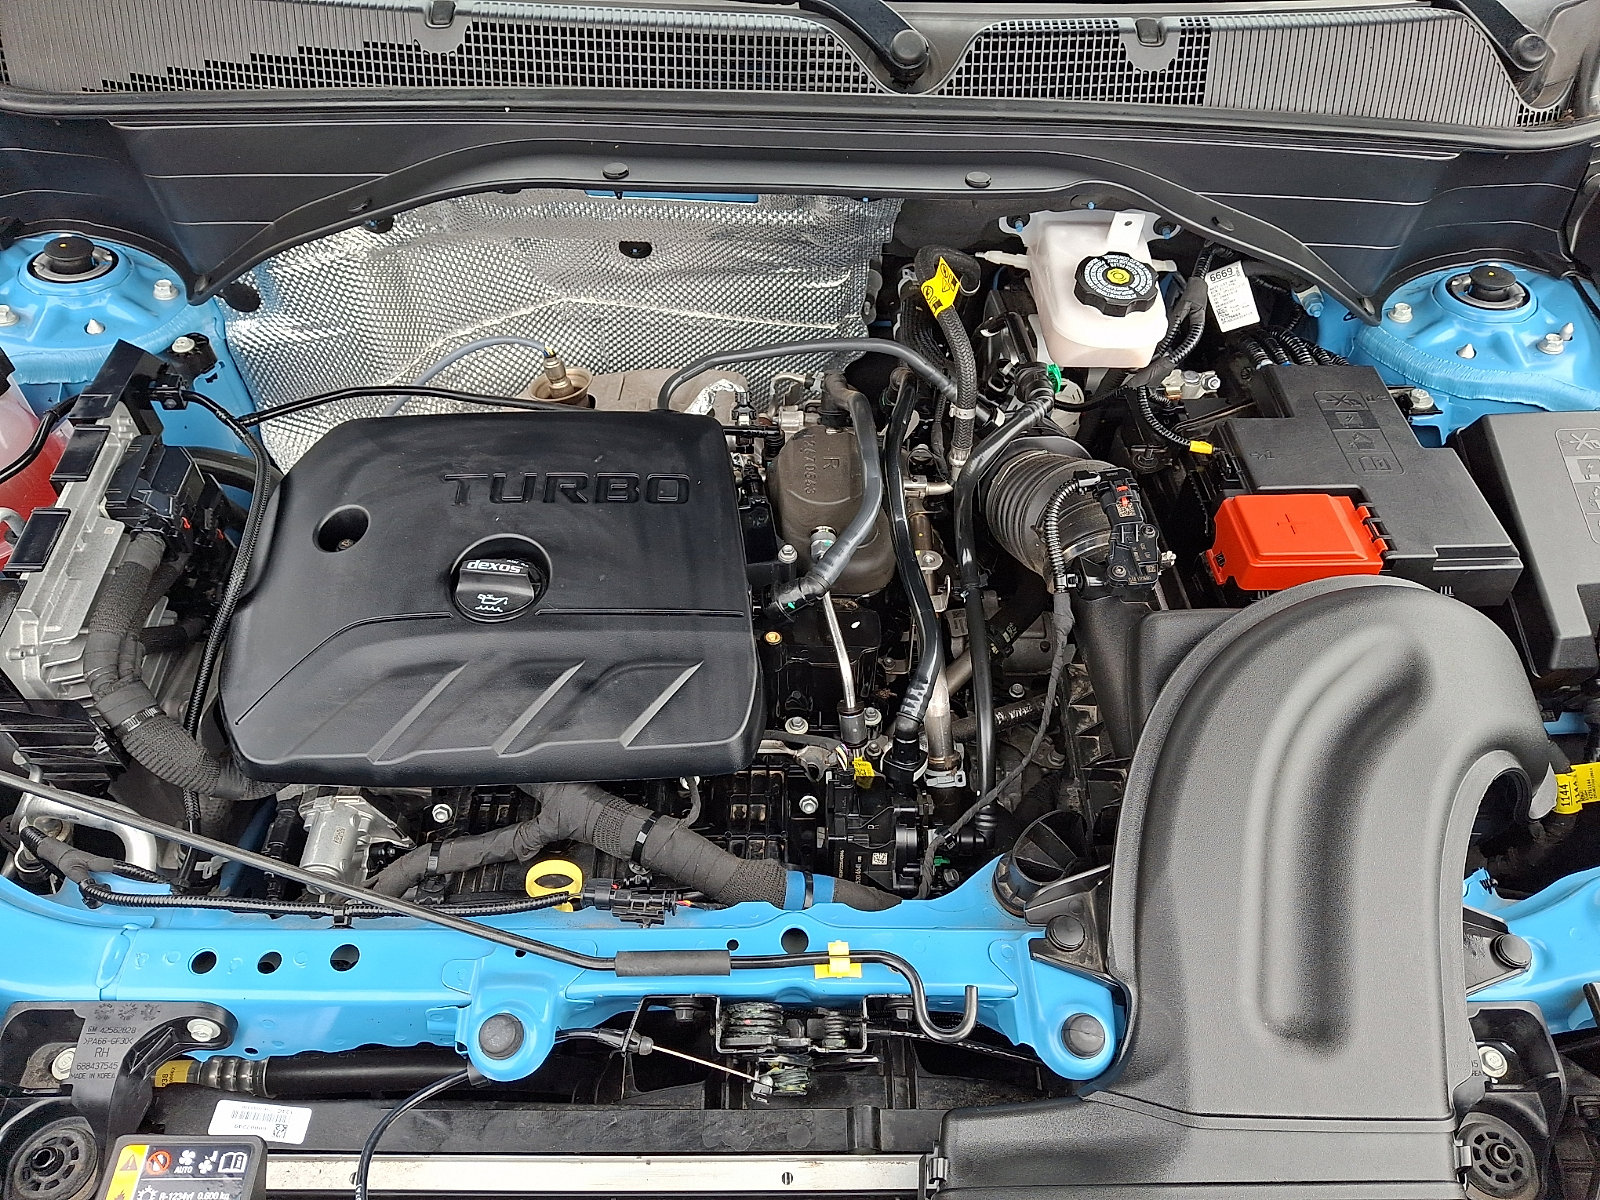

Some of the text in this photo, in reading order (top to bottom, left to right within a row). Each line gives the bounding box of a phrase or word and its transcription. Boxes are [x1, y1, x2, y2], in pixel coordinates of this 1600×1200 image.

[1209, 267, 1233, 282] 6669
[823, 456, 840, 470] R
[444, 472, 690, 505] TURBO
[466, 560, 524, 574] dexos
[1560, 784, 1570, 807] 1144
[94, 1047, 111, 1058] RH
[174, 1165, 194, 1174] AUTO
